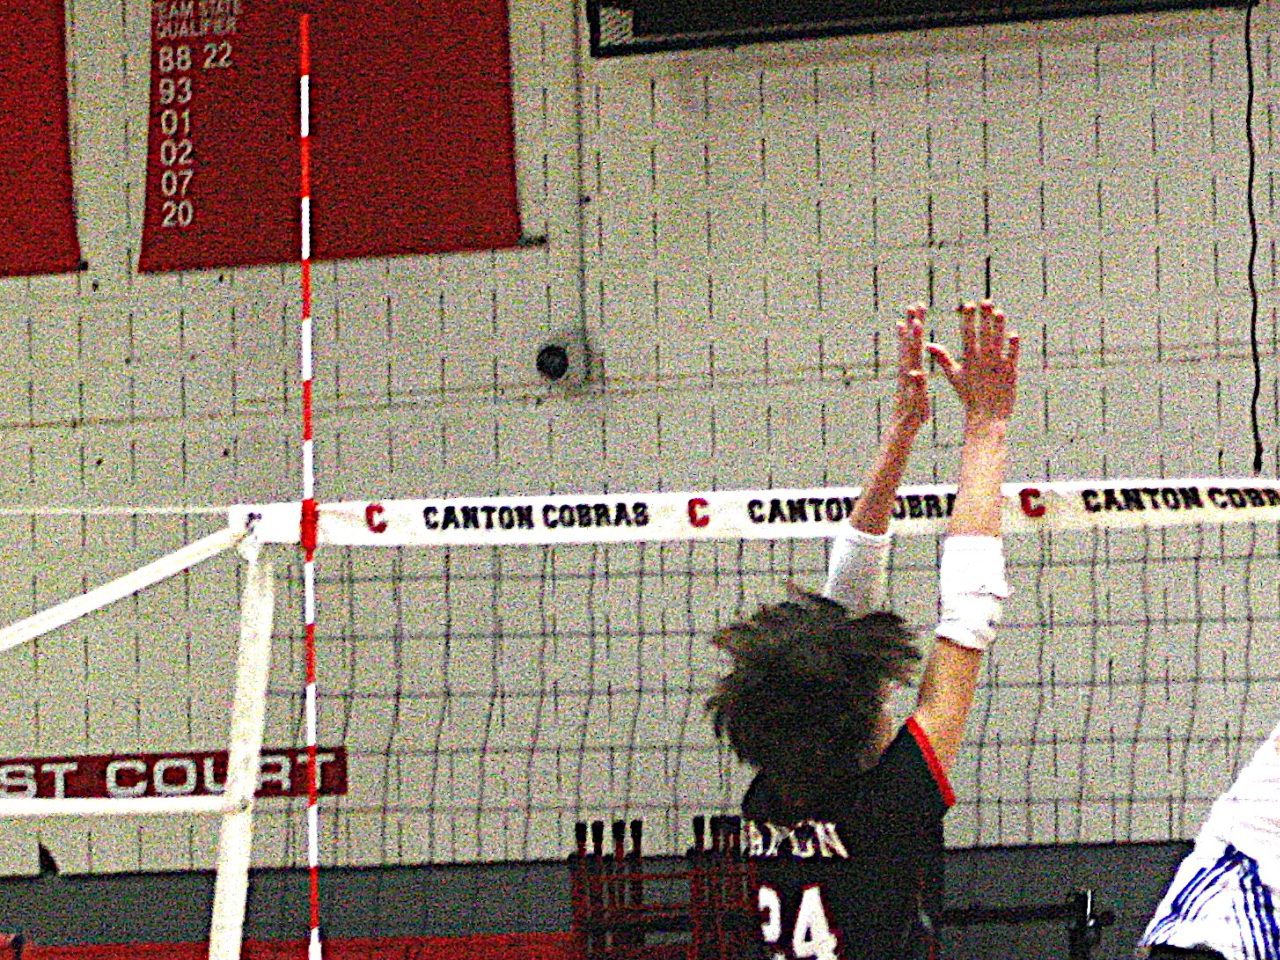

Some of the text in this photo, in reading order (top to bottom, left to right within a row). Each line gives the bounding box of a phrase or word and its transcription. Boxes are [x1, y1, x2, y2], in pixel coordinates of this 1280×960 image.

[159, 41, 232, 73] 88 22
[160, 109, 191, 135] 01
[160, 139, 194, 166] 02
[161, 170, 194, 197] 07
[161, 200, 194, 227] 20
[687, 497, 711, 528] C
[1019, 488, 1046, 518] C
[1081, 487, 1204, 512] CANTON
[364, 503, 388, 533] C
[422, 502, 650, 530] CANTON COBRAS
[105, 752, 335, 797] COURT
